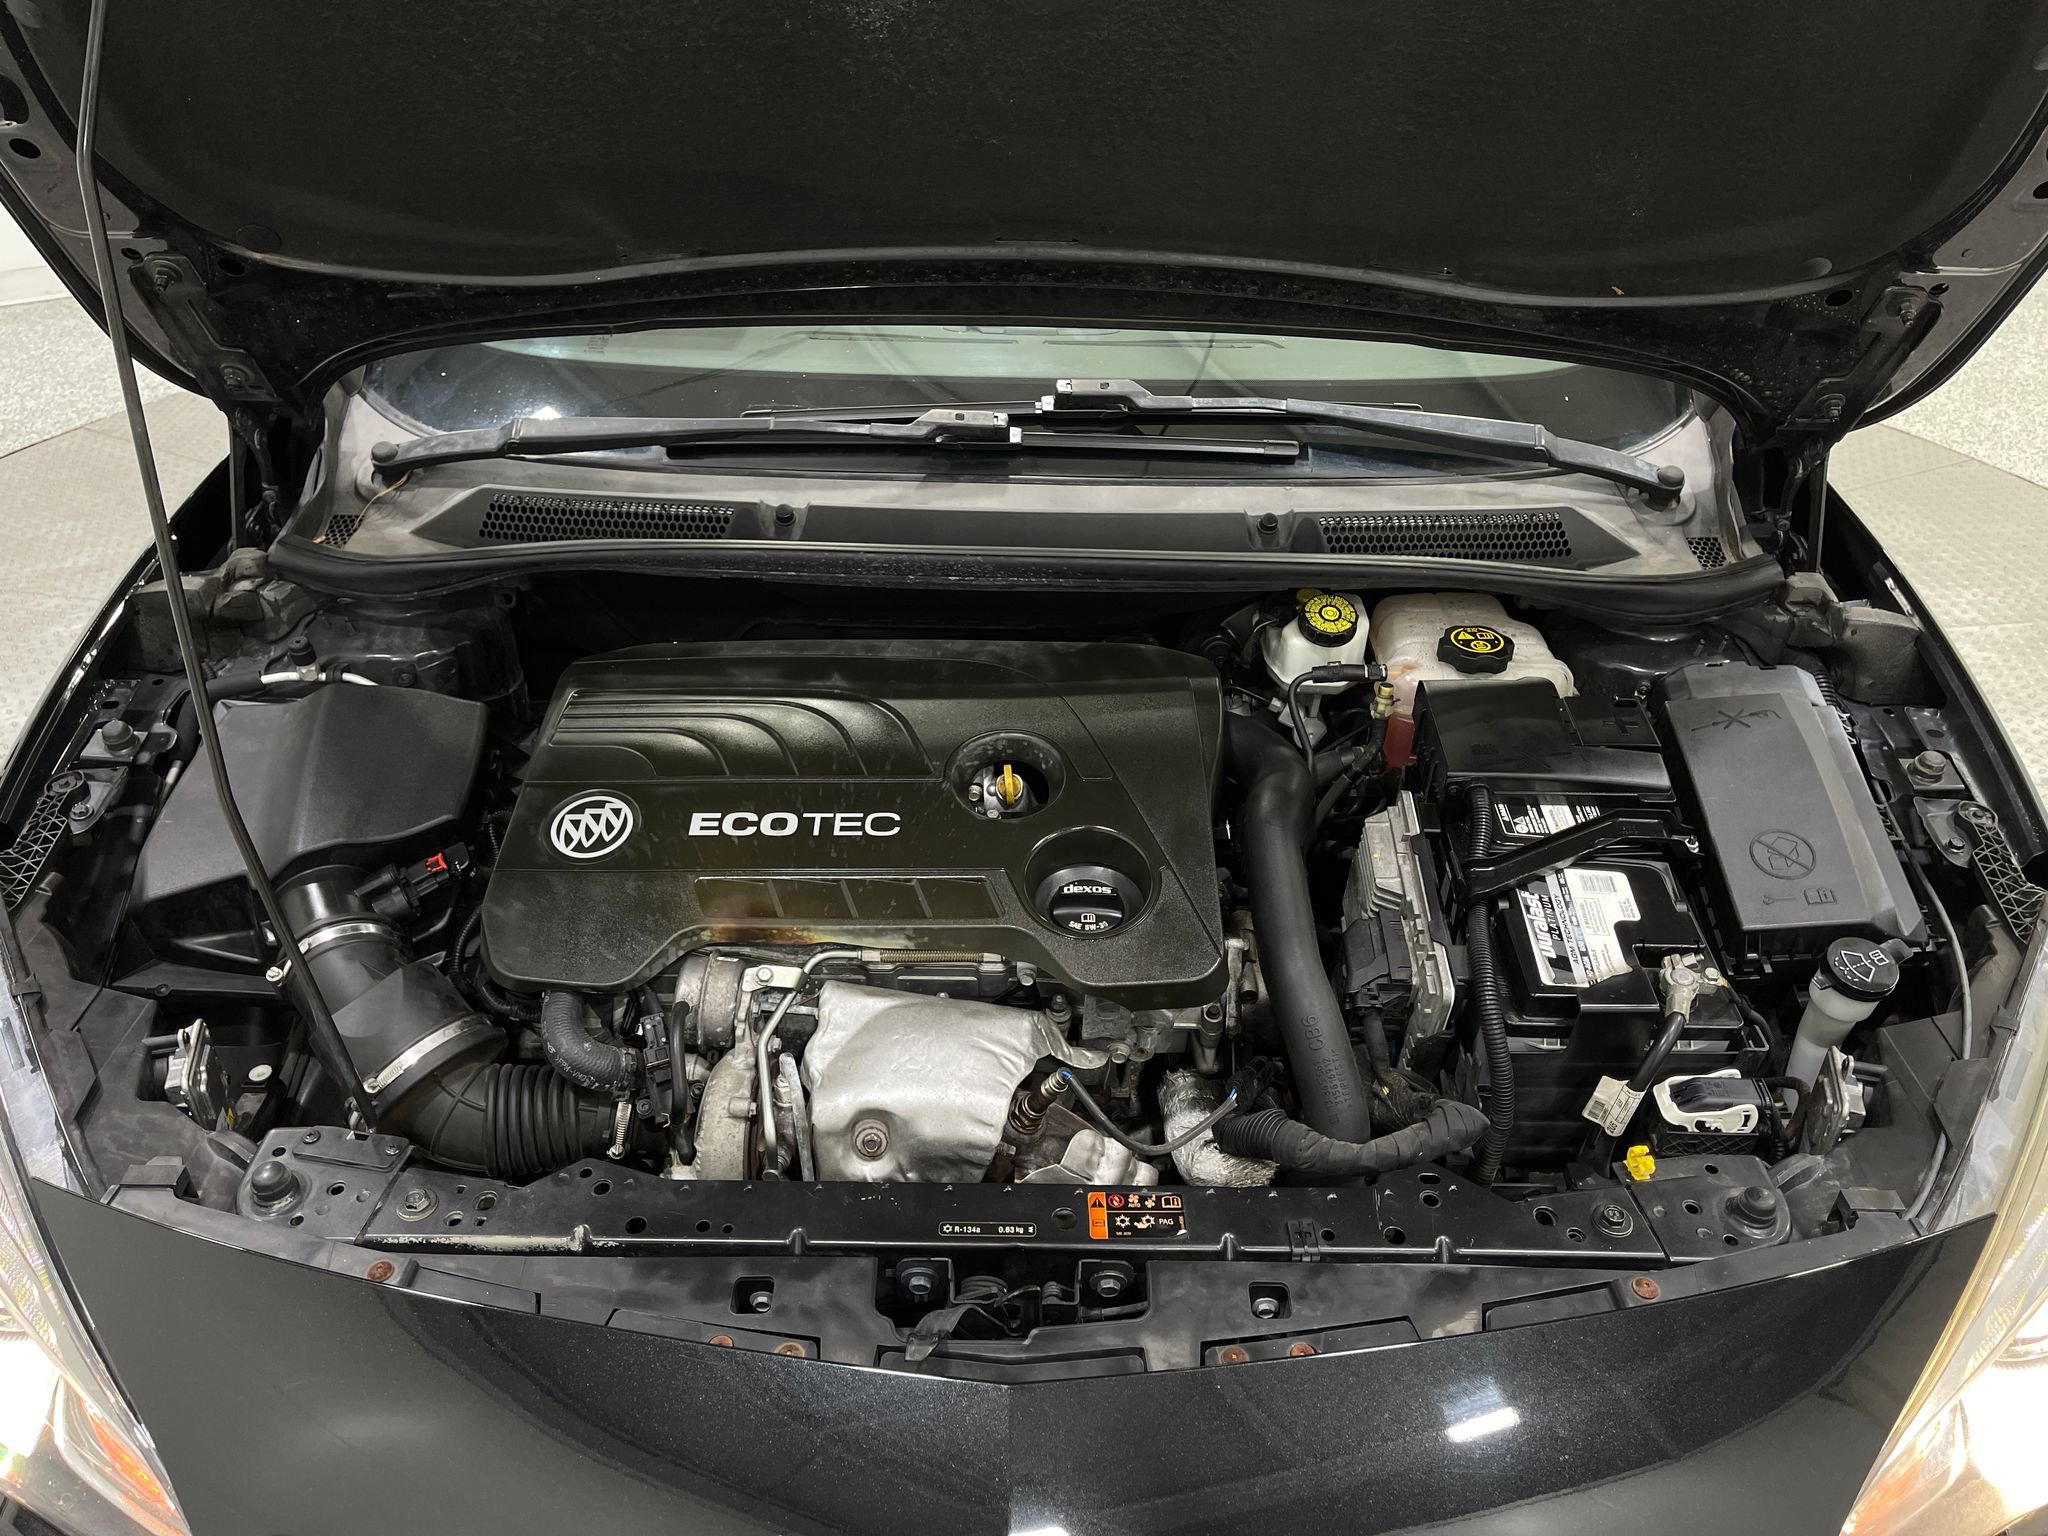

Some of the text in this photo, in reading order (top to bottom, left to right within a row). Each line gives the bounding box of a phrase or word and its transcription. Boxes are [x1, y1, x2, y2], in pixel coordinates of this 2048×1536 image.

[688, 812, 901, 837] ECOTEC
[1063, 884, 1113, 894] dexos
[1068, 921, 1109, 931] SAE 5W-30
[1541, 894, 1561, 941] PLATINUM
[1554, 894, 1573, 944] TECHNOLOGY
[1569, 944, 1580, 965] AGM
[954, 1225, 981, 1234] R-134a
[998, 1226, 1015, 1234] 0.63
[1015, 1226, 1024, 1234] kg
